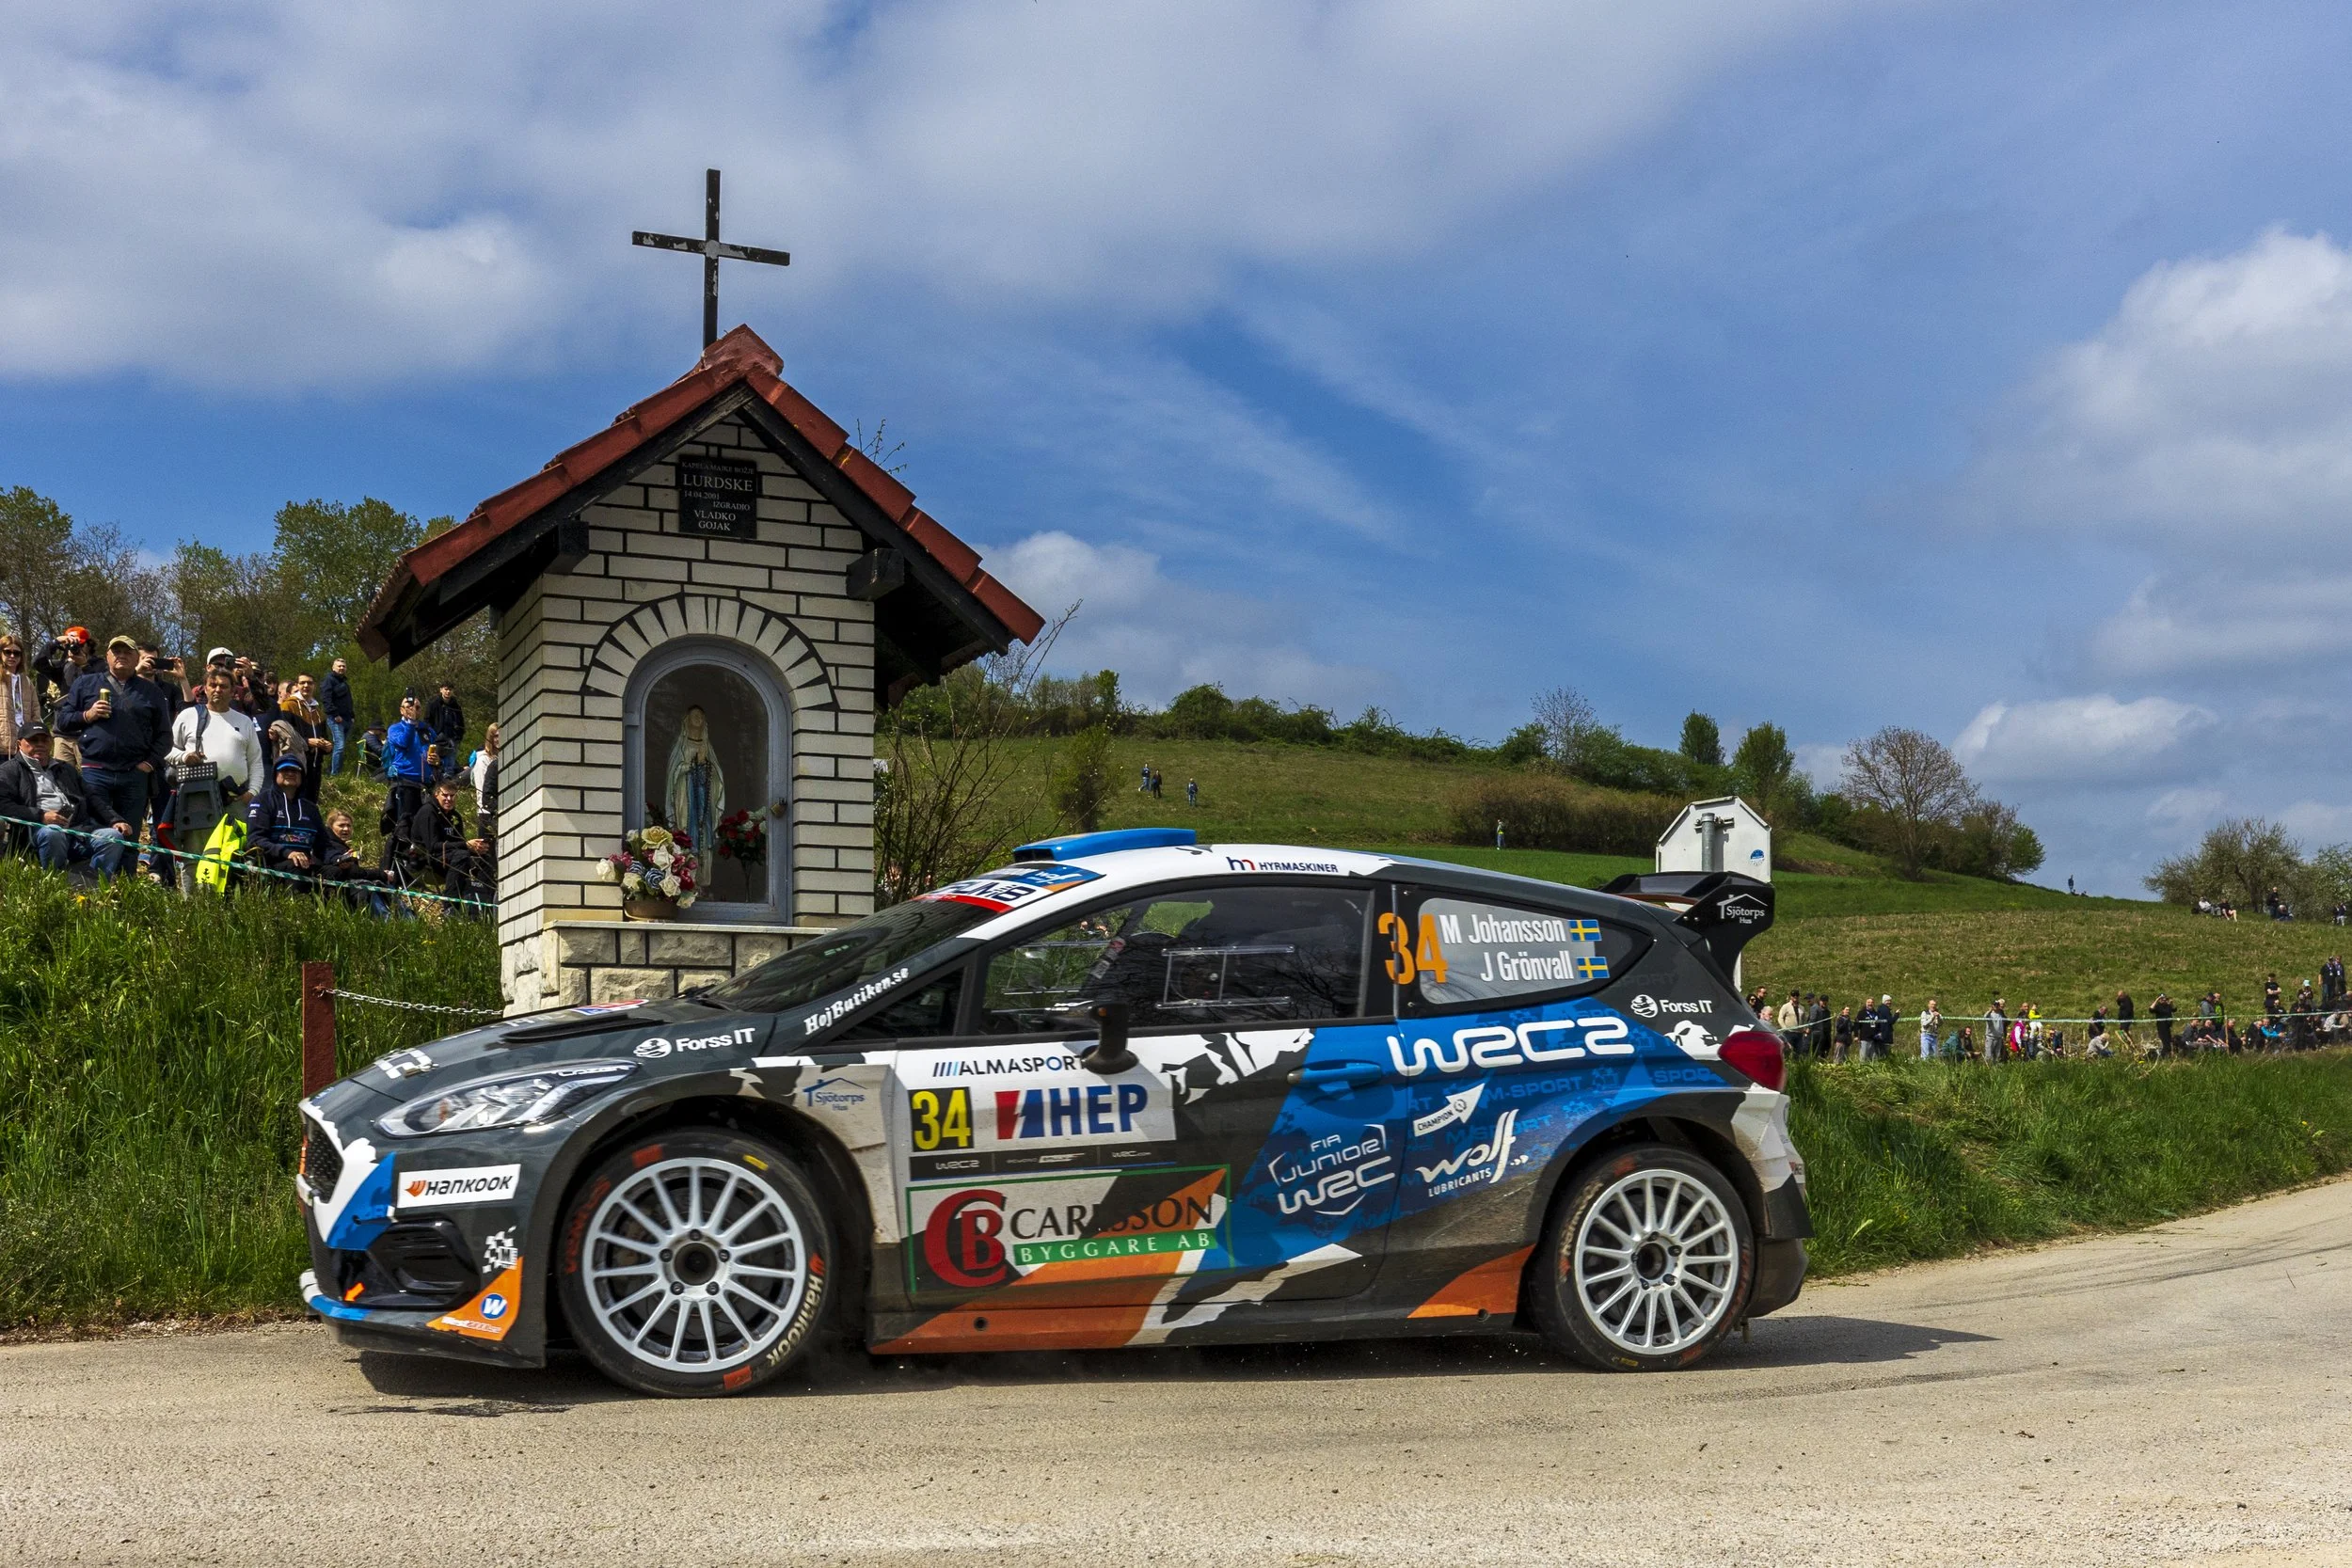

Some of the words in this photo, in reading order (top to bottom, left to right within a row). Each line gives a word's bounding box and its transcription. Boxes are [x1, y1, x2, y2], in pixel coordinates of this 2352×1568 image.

[683, 473, 753, 492] LURDSKE
[694, 509, 737, 522] VLADKO
[713, 500, 751, 512] IZGRADIO
[698, 520, 731, 531] GOJAK
[1259, 862, 1339, 873] HYRMASKINER
[1726, 906, 1765, 920] Sjötorps
[1438, 914, 1462, 944] M
[1468, 914, 1566, 944] Johansson
[1377, 911, 1449, 986] 34
[1480, 952, 1493, 982] J
[1496, 950, 1575, 982] Grönvall
[1660, 999, 1698, 1013] Forss
[1698, 1000, 1713, 1014] IT
[675, 1034, 733, 1052] Forss
[733, 1027, 755, 1044] IT
[1386, 1016, 1635, 1078] WRC2
[959, 1055, 1083, 1077] ALMASPORT
[815, 1091, 866, 1105] Sjötorps
[912, 1089, 971, 1150] 34
[1049, 1084, 1148, 1137] HEP
[1417, 1108, 1454, 1131] CHAMPION
[1311, 1134, 1342, 1152] FIA
[1280, 1137, 1381, 1182] JUNIOR
[1278, 1155, 1395, 1214] WRC
[1428, 1167, 1491, 1197] LUBRICANTS
[1009, 1195, 1214, 1240] CARSSON
[1020, 1236, 1158, 1263] BYGGARE
[1177, 1232, 1212, 1249] AB
[483, 1298, 508, 1316] W
